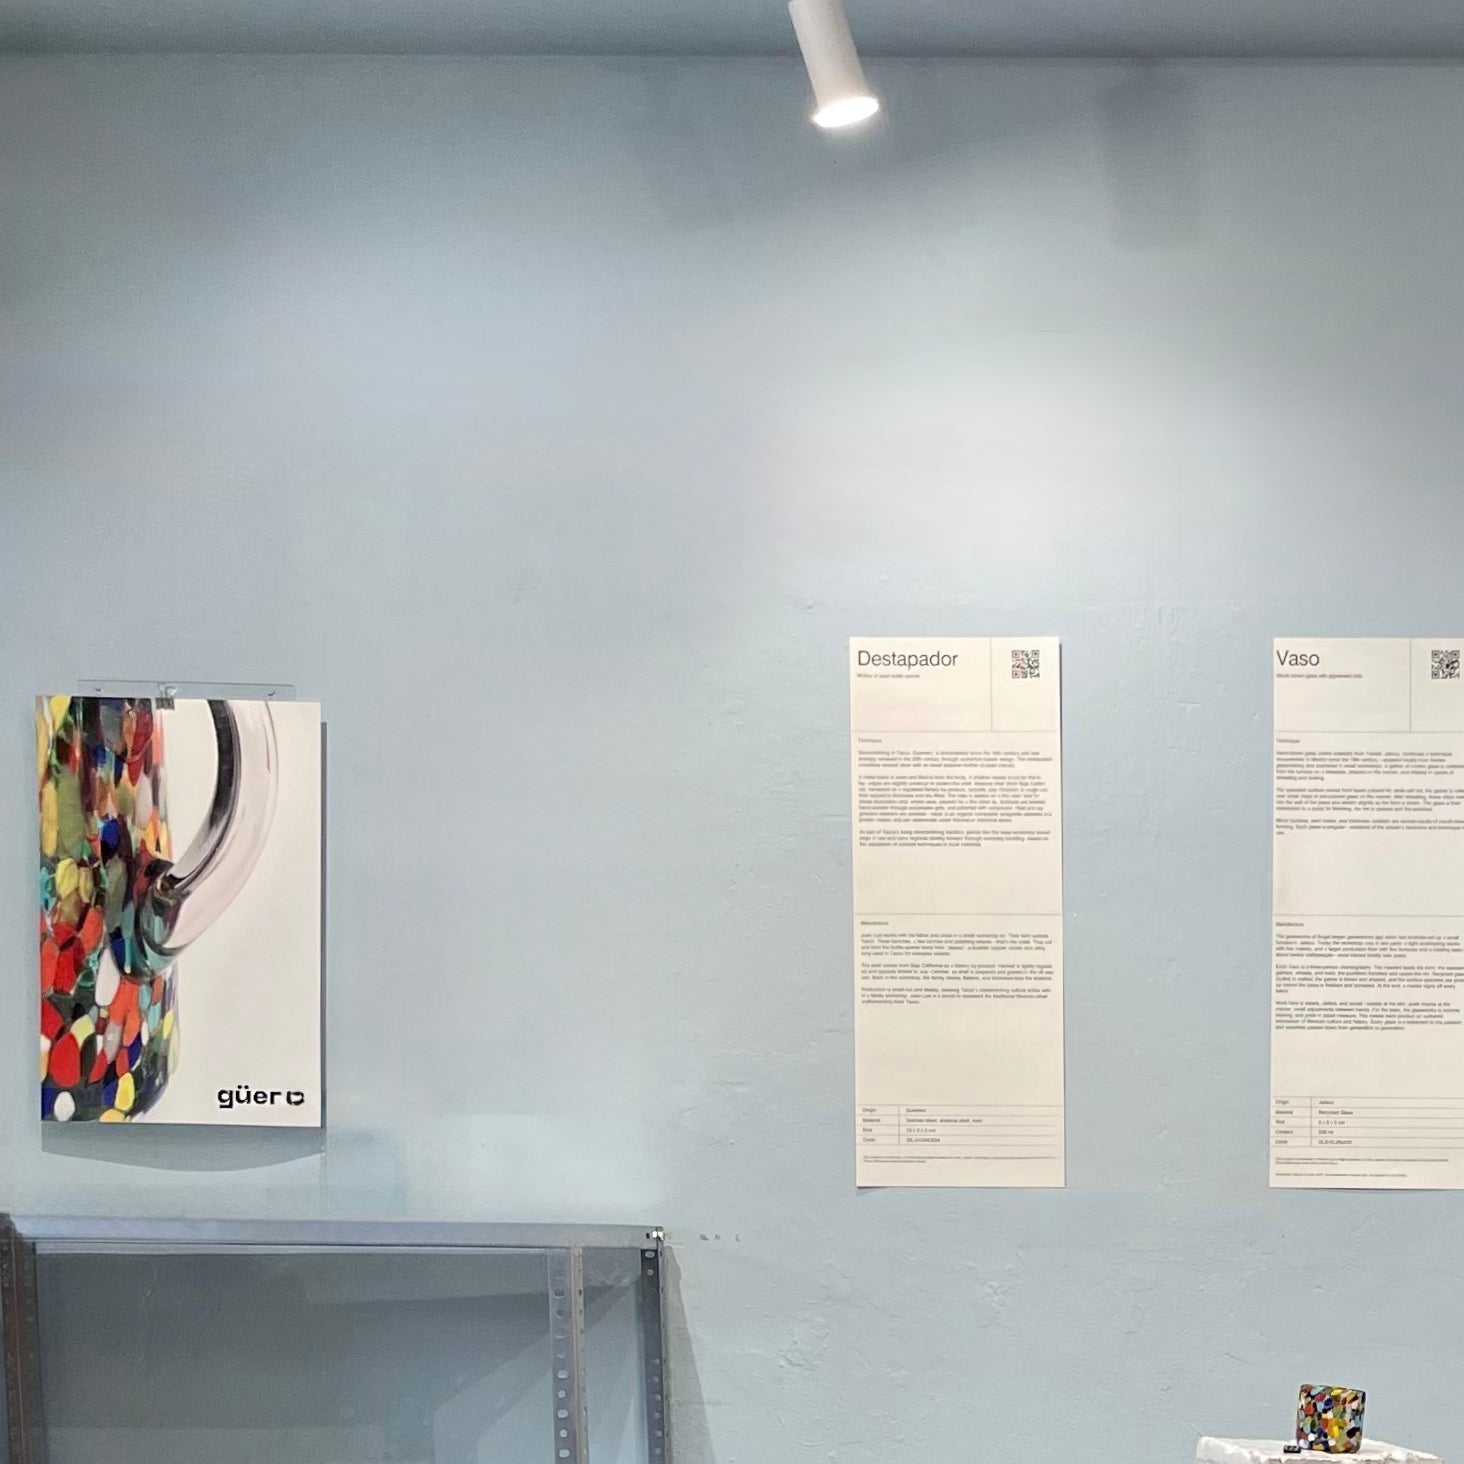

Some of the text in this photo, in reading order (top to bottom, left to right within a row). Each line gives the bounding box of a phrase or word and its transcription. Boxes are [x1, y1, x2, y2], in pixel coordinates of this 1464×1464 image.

[858, 650, 958, 670] Destapador
[1276, 650, 1320, 666] Vaso
[217, 1085, 305, 1109] güero
